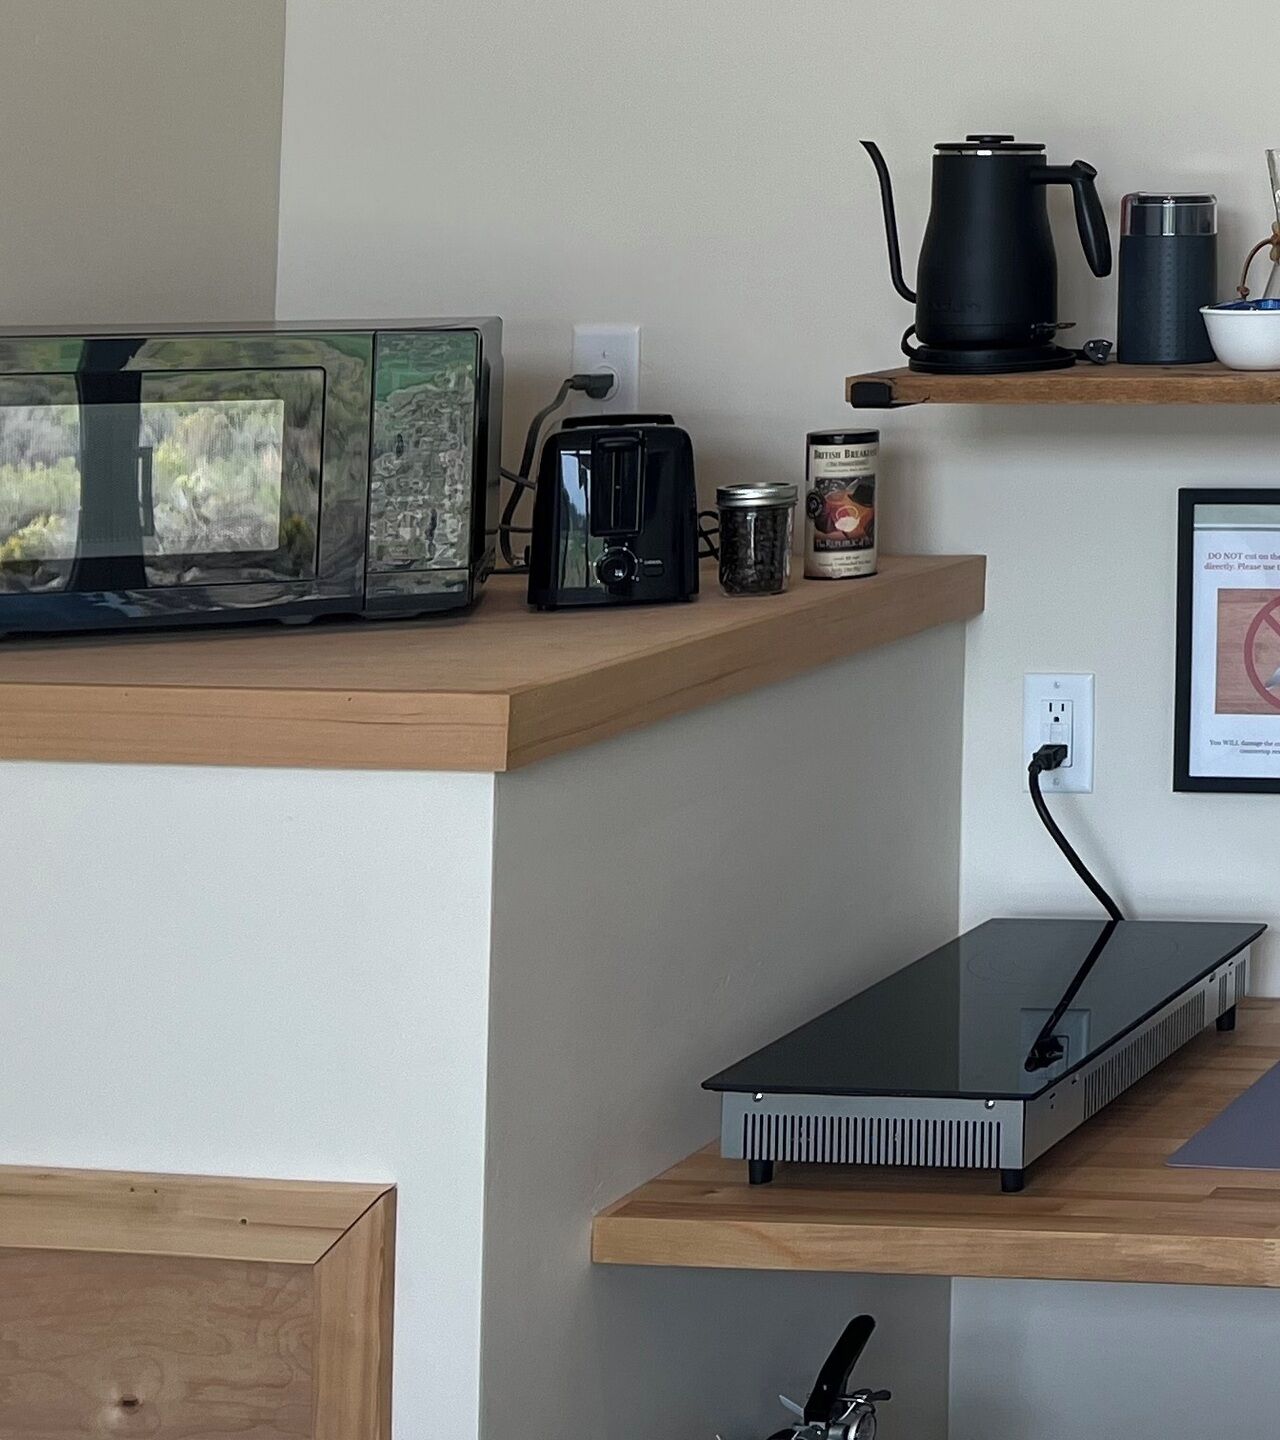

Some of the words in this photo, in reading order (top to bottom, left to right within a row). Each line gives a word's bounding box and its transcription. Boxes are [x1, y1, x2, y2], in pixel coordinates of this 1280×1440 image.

[814, 449, 841, 459] BRITISH
[1208, 552, 1222, 560] DO
[1223, 552, 1243, 560] NOT
[1237, 562, 1261, 570] Please
